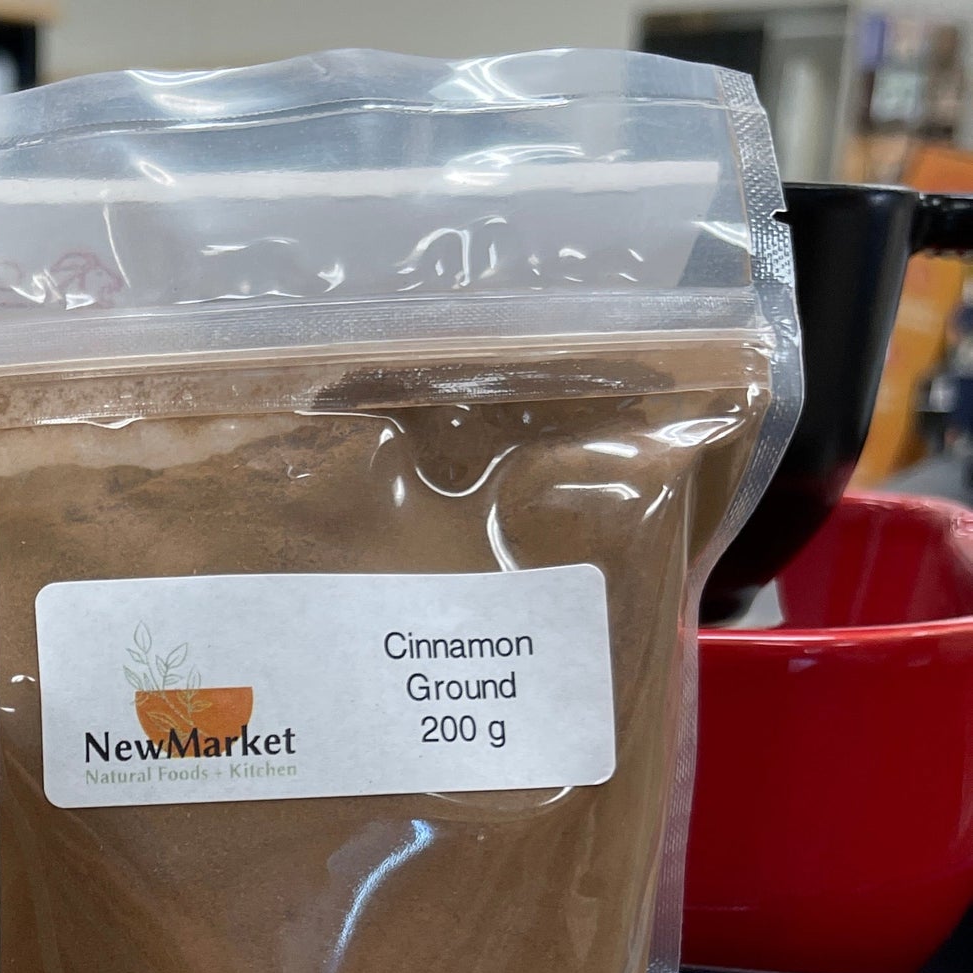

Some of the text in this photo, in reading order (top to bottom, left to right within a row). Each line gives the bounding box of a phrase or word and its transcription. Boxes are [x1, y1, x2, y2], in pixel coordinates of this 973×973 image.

[383, 631, 533, 660] Cinnamon
[406, 671, 517, 701] Ground
[84, 725, 296, 762] NewMarket
[421, 715, 507, 748] 200 g
[85, 766, 152, 784] Natural
[158, 764, 209, 781] Foods
[230, 762, 297, 778] Kitchen
